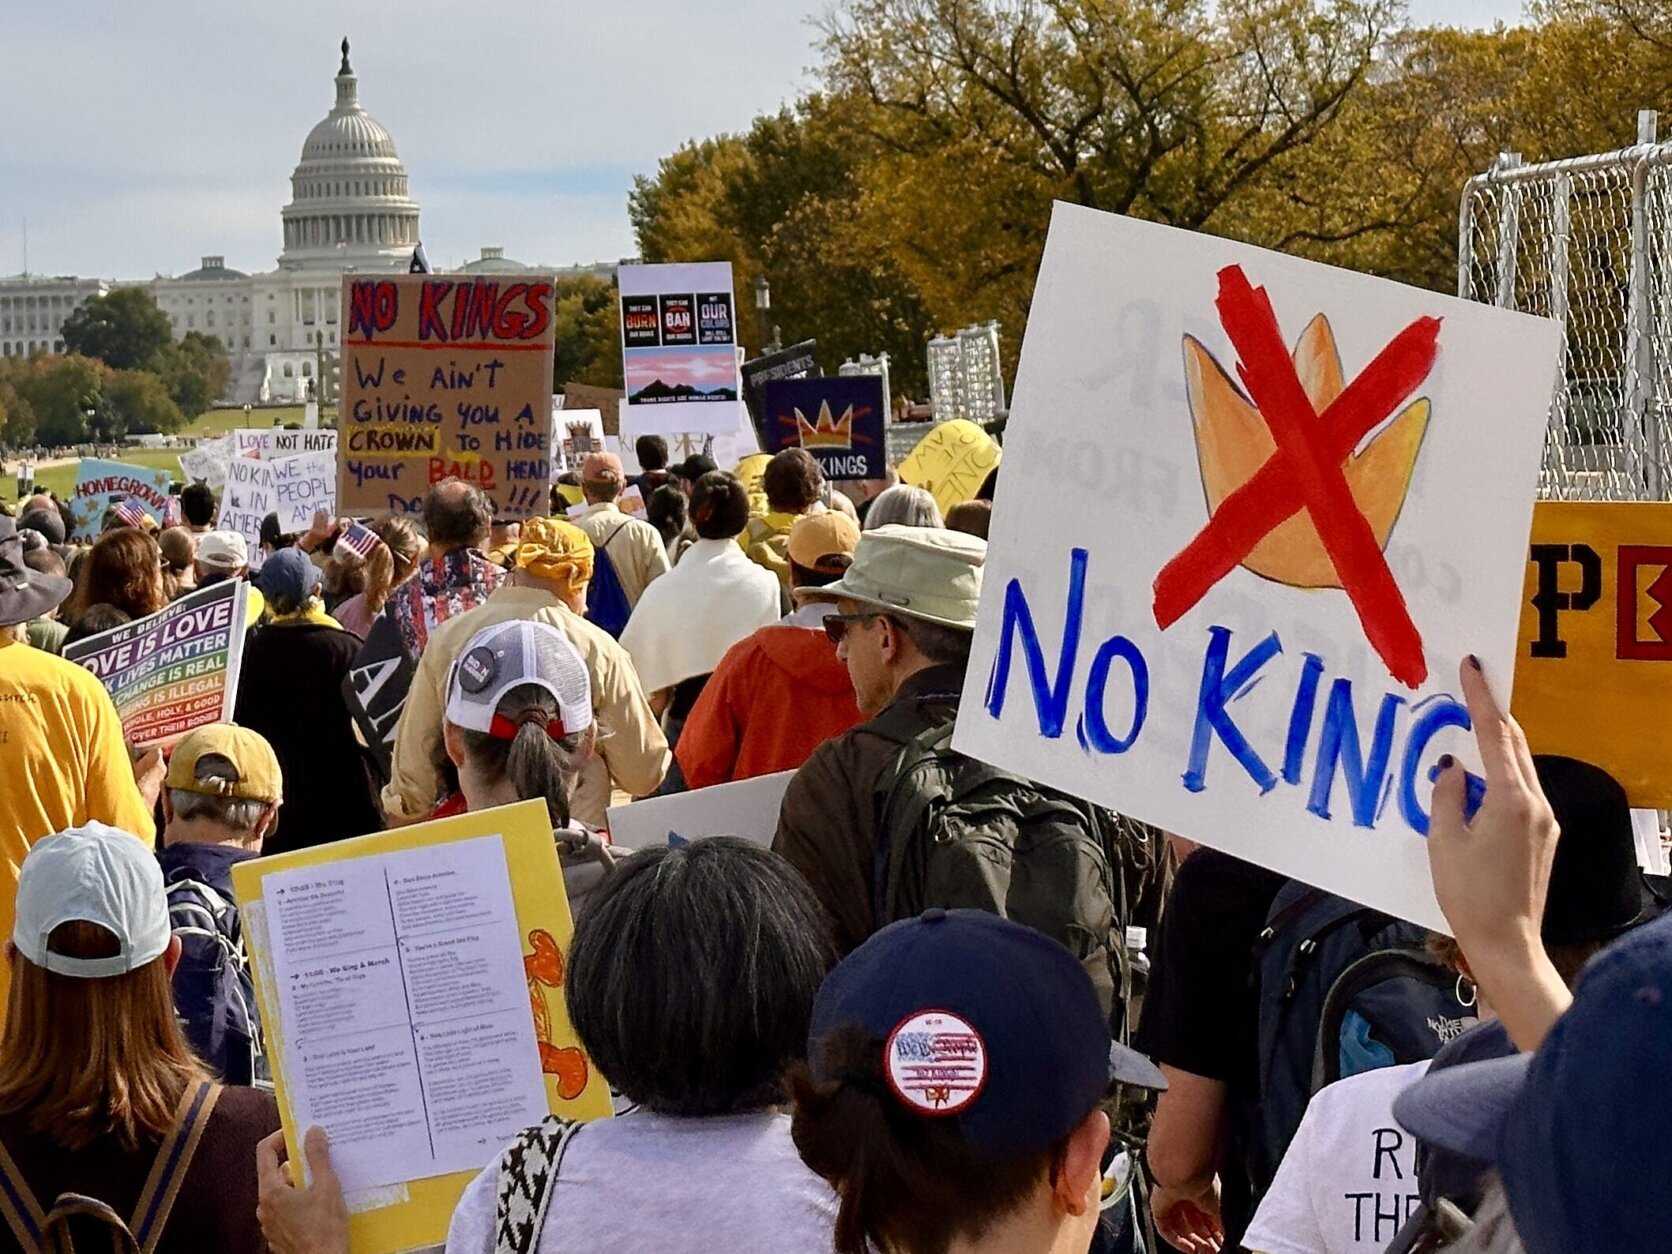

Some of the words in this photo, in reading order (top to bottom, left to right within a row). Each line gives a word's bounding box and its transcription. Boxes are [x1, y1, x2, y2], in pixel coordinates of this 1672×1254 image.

[348, 279, 398, 341] NO
[418, 277, 554, 341] KINGS
[666, 312, 690, 327] BAN
[702, 303, 727, 319] OUR
[626, 314, 656, 329] BURN
[750, 354, 814, 386] PRESIDENTS
[514, 403, 535, 425] A
[239, 434, 270, 449] LOVE
[276, 435, 299, 450] NOT
[349, 426, 436, 451] CROWN
[228, 462, 248, 483] NO
[272, 459, 302, 480] WE
[428, 456, 496, 488] BALD
[506, 459, 549, 480] HEAD
[817, 455, 868, 477] KINGS
[75, 475, 165, 510] HOMEGROWN
[249, 490, 268, 512] IN
[111, 629, 131, 644] WE
[136, 632, 157, 660] IS
[161, 602, 231, 642] LOVE
[117, 656, 156, 688] LIVES
[159, 634, 227, 666] MATTER
[116, 671, 165, 706] CHANGE
[169, 665, 182, 682] IS
[185, 655, 225, 677] REAL
[153, 688, 166, 702] IS
[169, 675, 223, 697] ILLEGAL
[194, 694, 221, 710] GOOD
[131, 725, 158, 742] OVER
[1372, 1127, 1419, 1180] R
